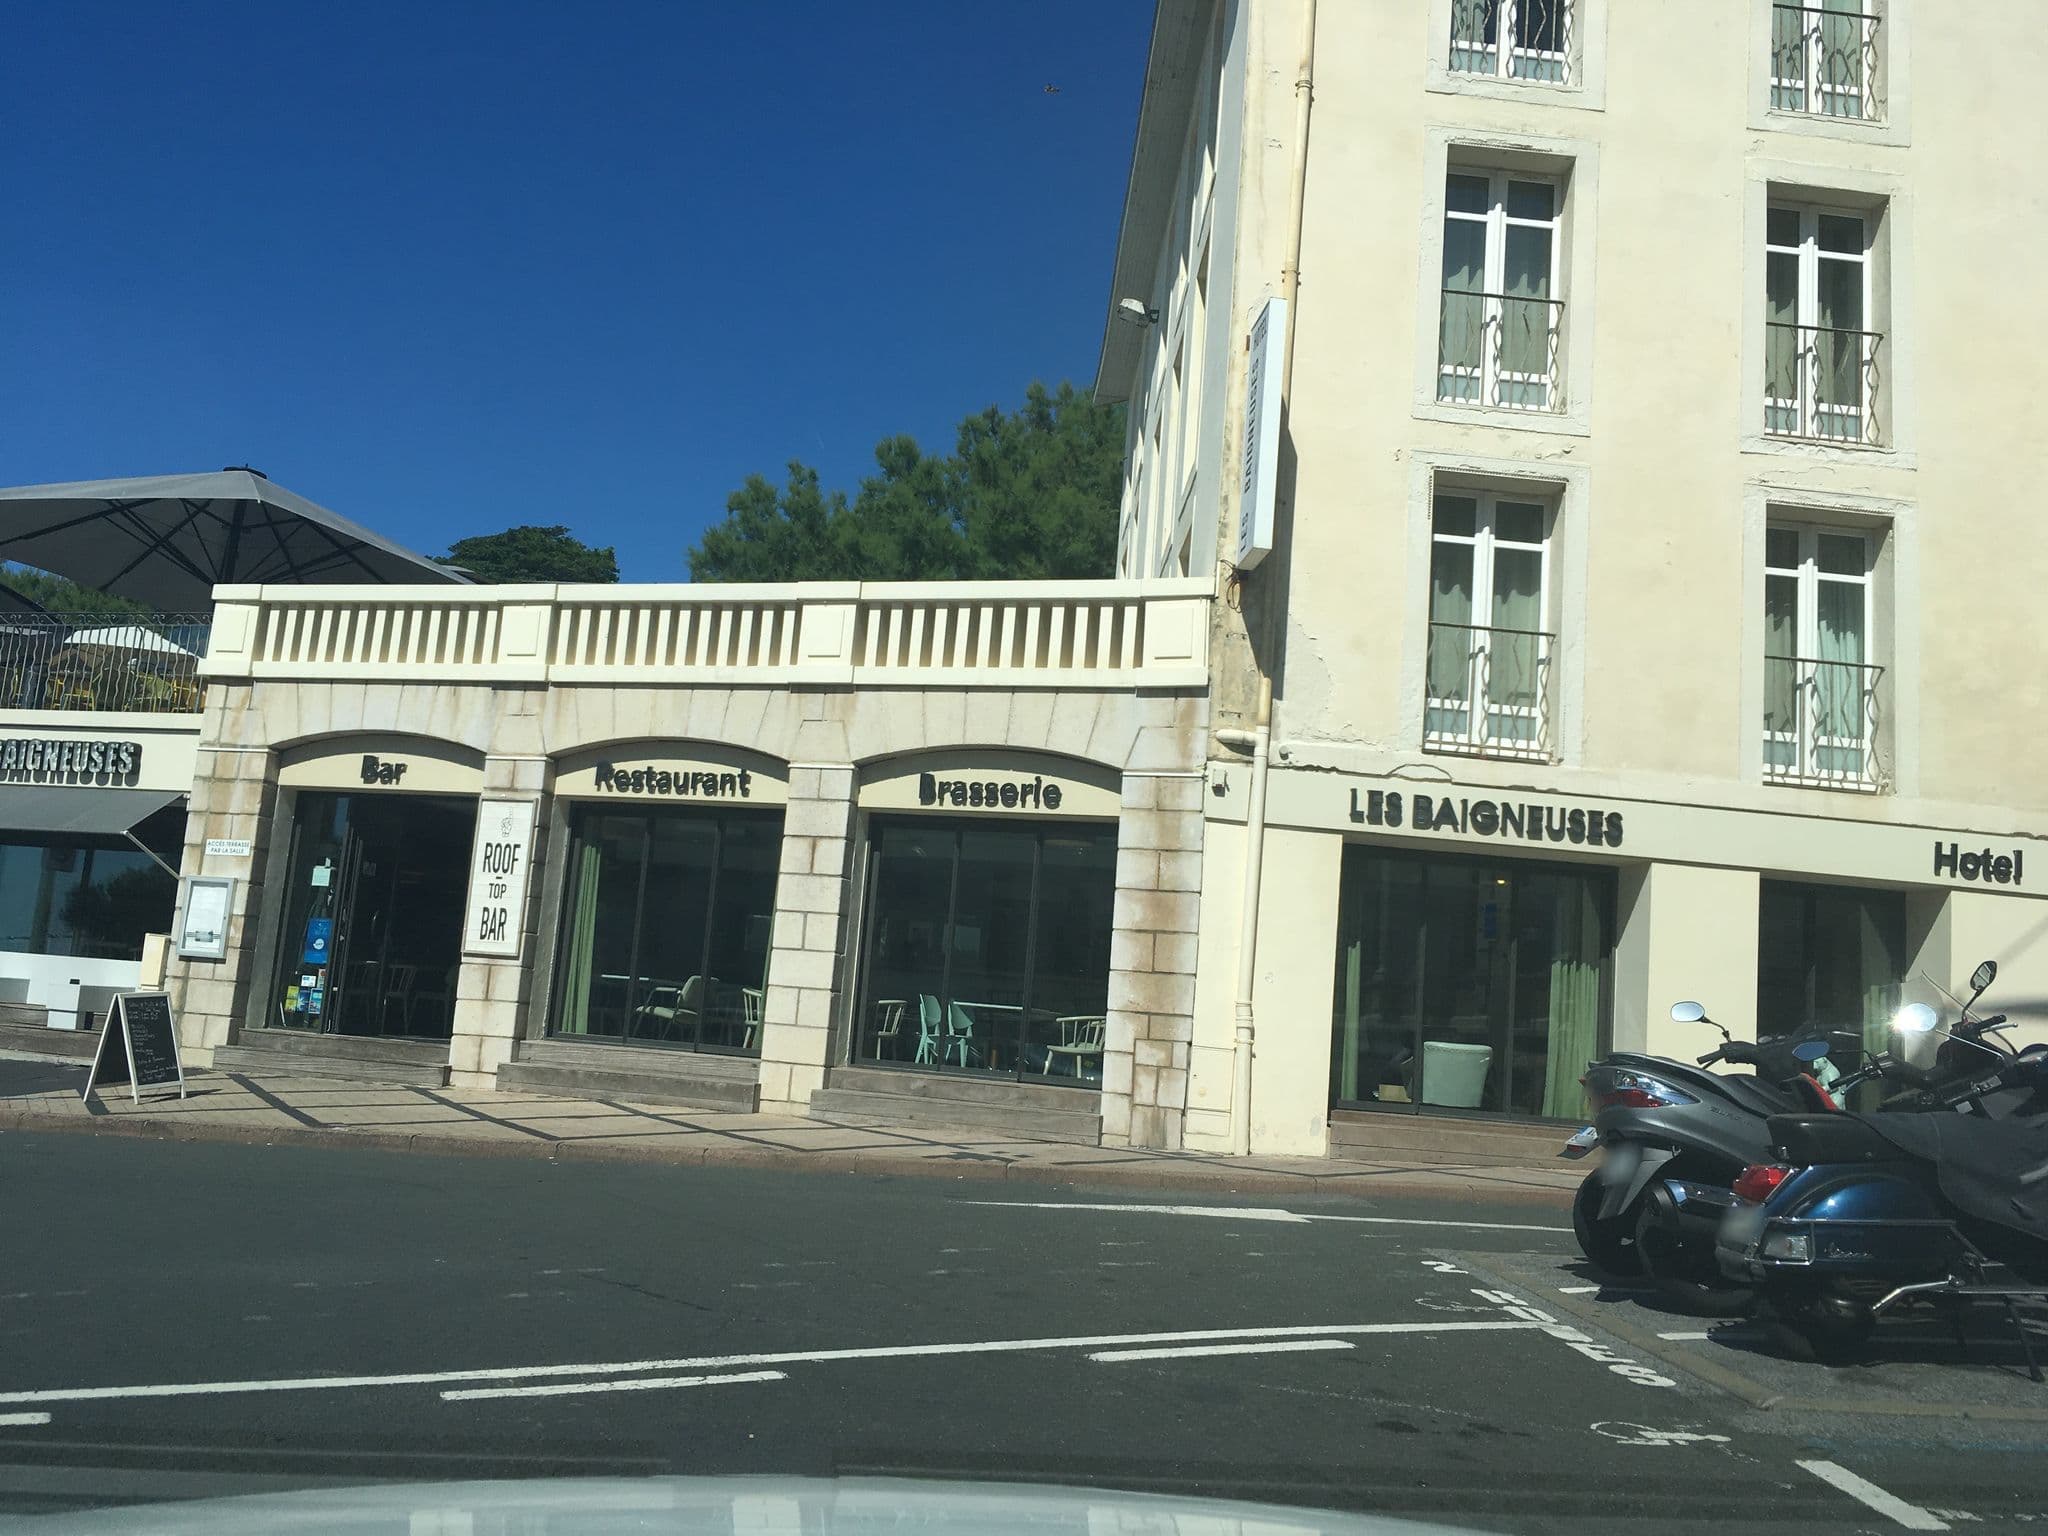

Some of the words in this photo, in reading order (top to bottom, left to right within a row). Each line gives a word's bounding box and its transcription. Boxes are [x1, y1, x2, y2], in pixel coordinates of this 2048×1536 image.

[0, 739, 138, 778] AIGNEUSES
[361, 755, 408, 785] Bar
[595, 761, 752, 798] Restaurant
[919, 773, 1062, 809] Brasserie
[1349, 788, 1403, 828] LES
[1412, 794, 1624, 848] BAIGNEUSES
[482, 842, 521, 875] ROOF
[1934, 841, 2023, 885] Hotel
[488, 883, 507, 899] TOP
[479, 906, 508, 942] BAR
